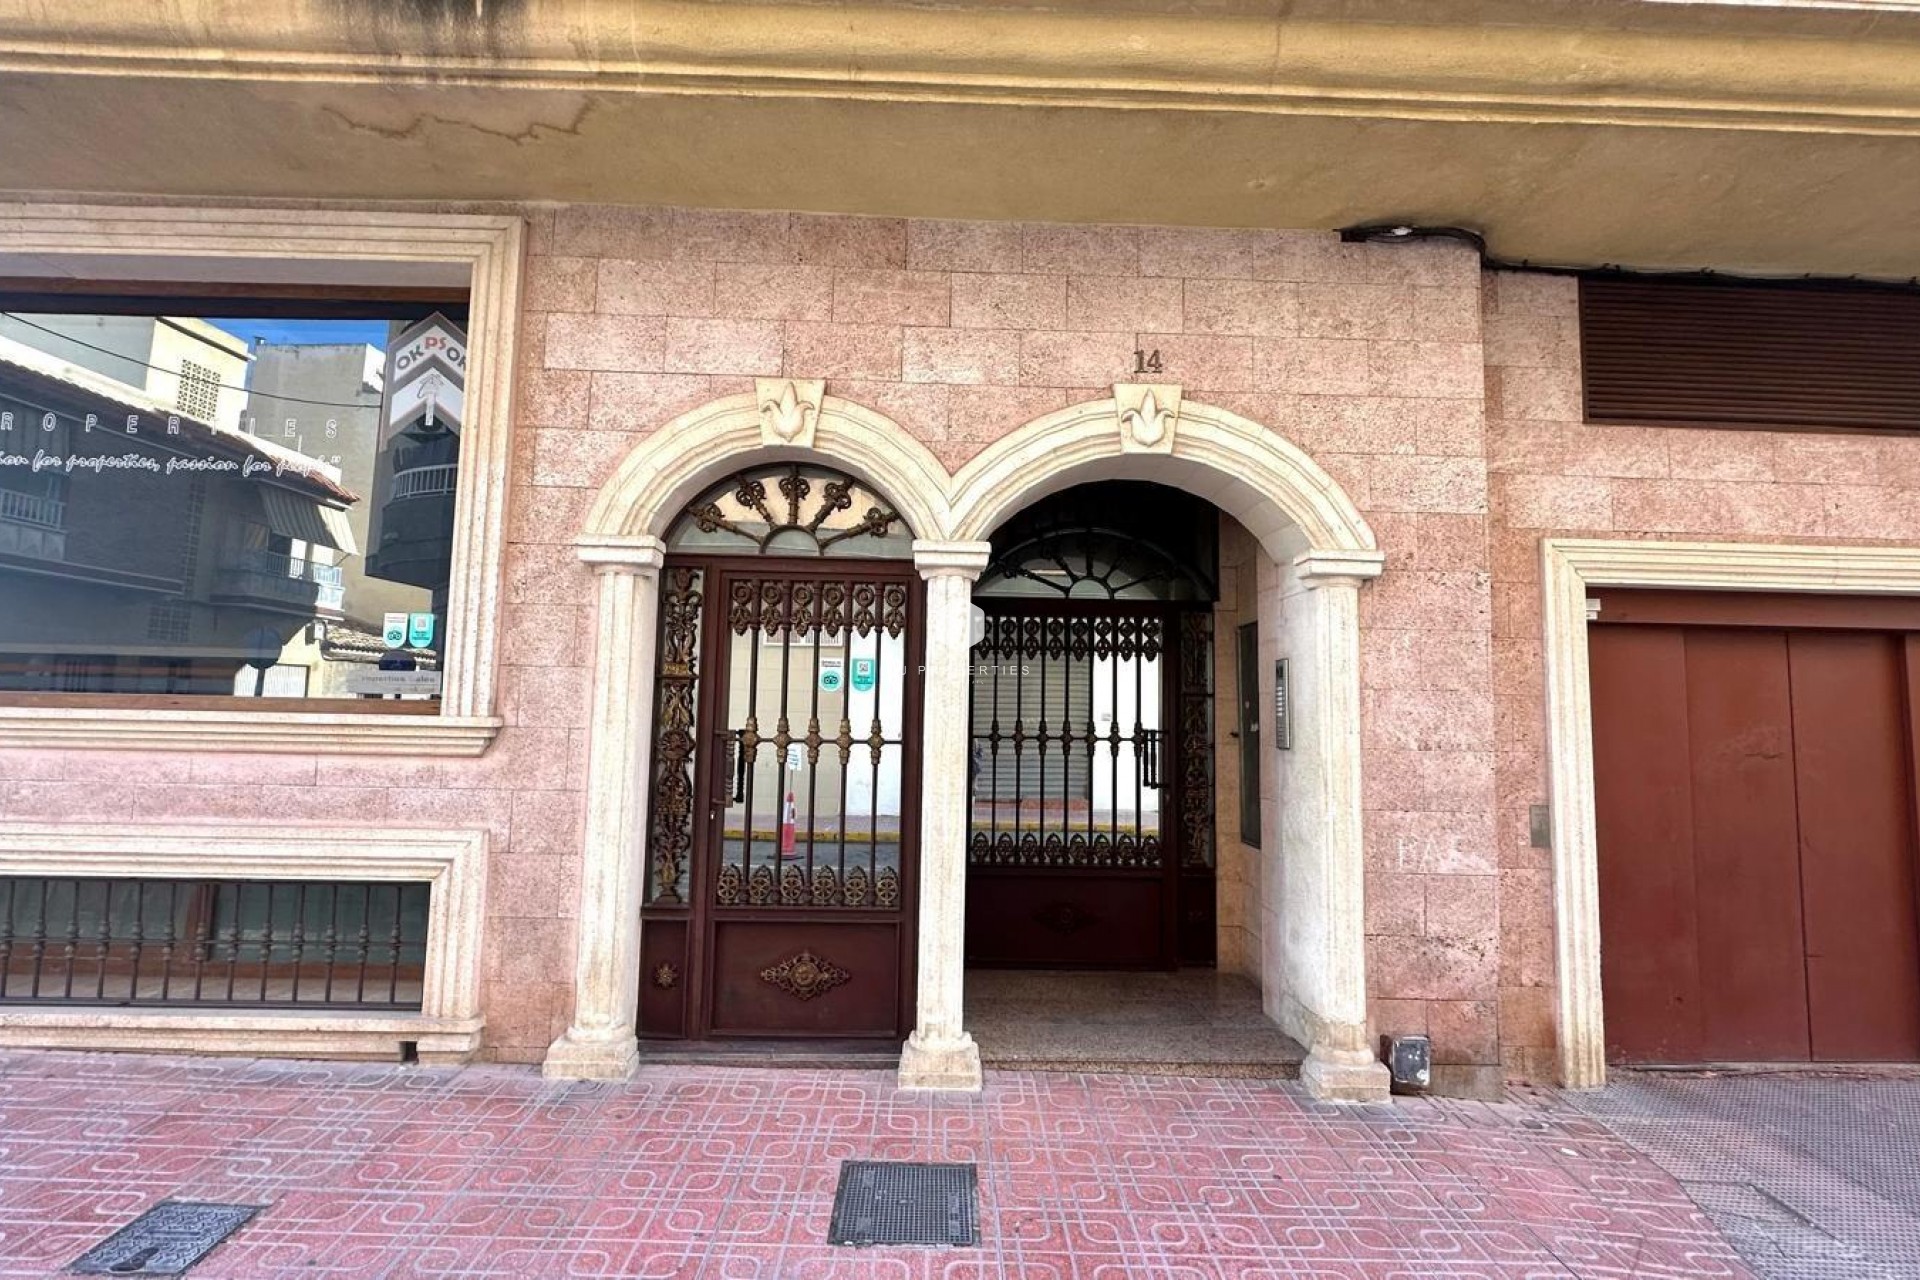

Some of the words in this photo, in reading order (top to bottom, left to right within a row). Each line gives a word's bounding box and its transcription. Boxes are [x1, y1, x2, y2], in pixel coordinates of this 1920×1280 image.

[1133, 348, 1163, 374] 14
[32, 449, 62, 473] for
[166, 455, 238, 475] passion
[242, 454, 272, 478] for
